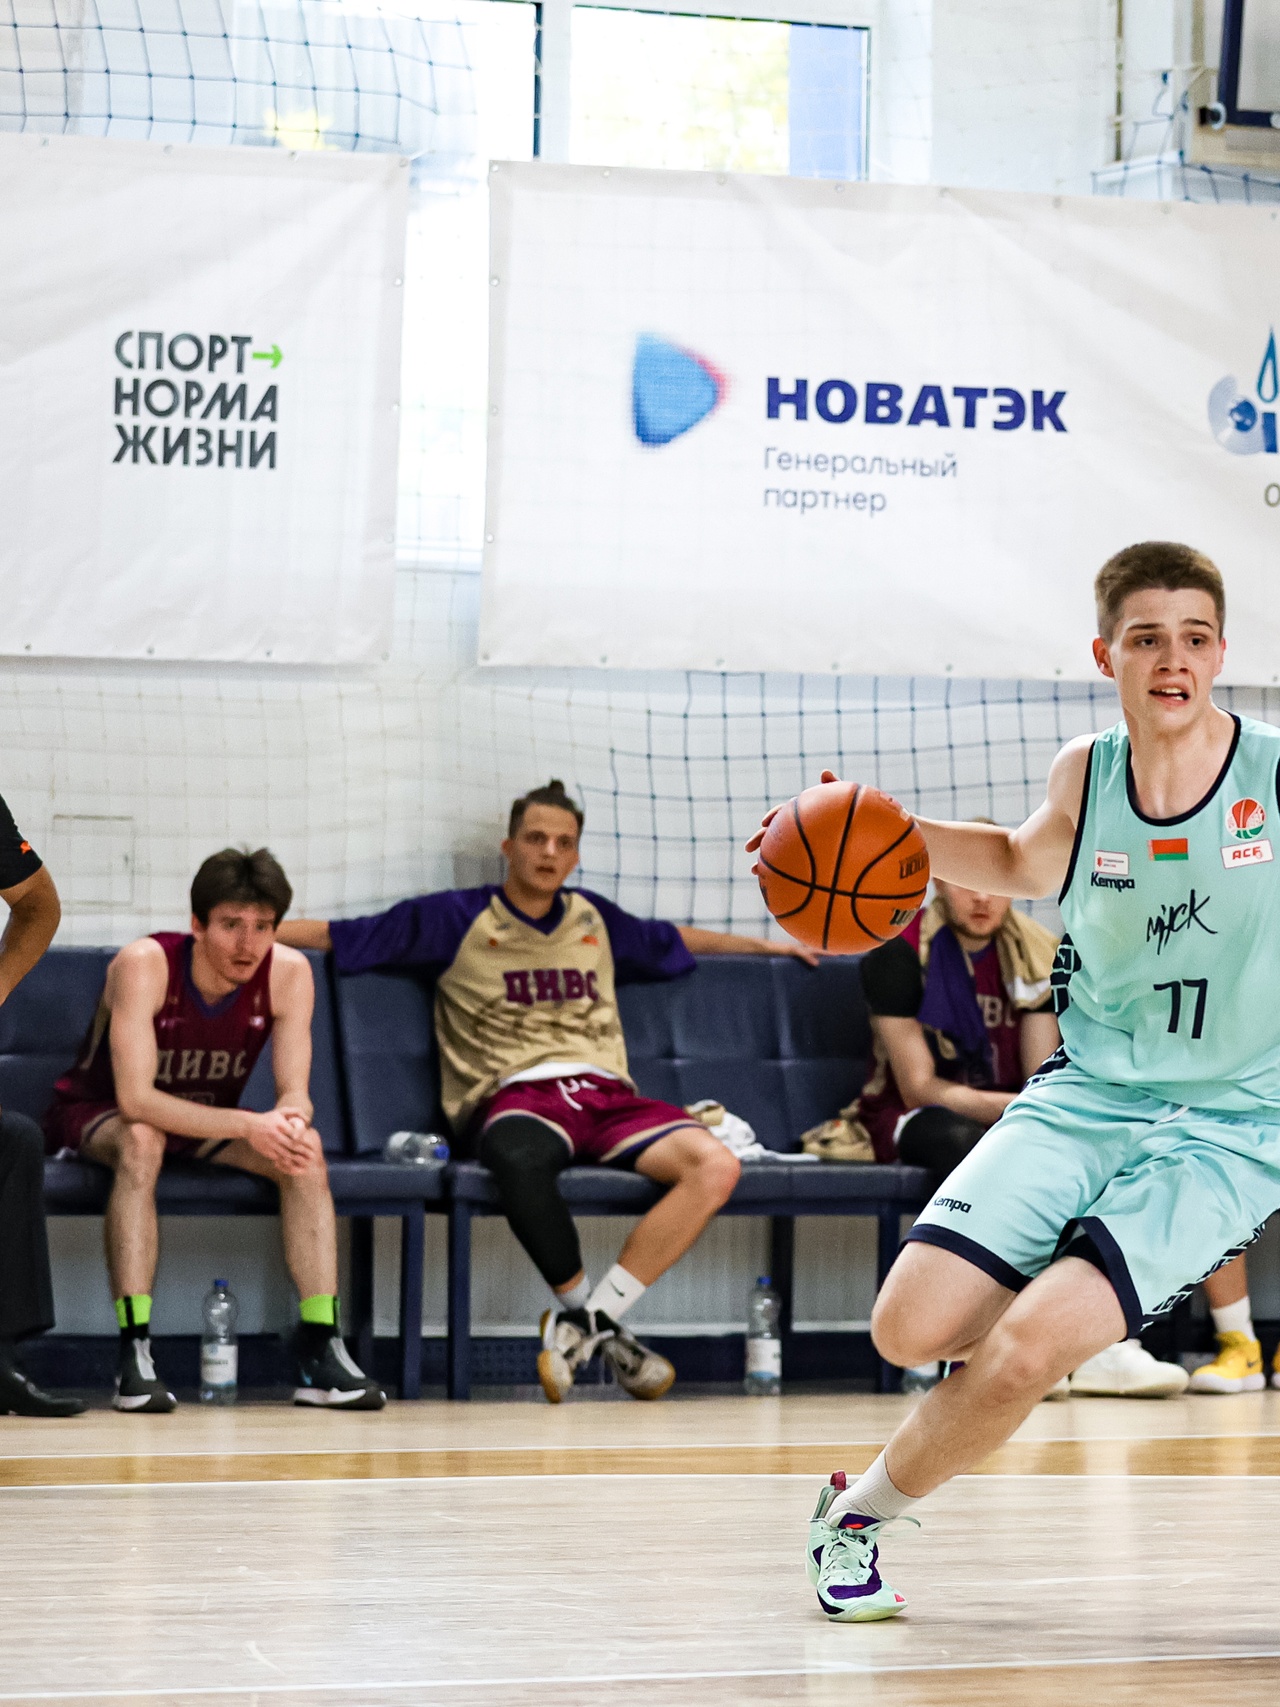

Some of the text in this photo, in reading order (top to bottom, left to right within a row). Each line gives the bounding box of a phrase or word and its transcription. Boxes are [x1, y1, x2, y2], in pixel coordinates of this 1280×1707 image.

[115, 331, 252, 373] СПОРТ
[114, 377, 278, 422] НОРМА
[766, 377, 1068, 433] НОВАТЭК
[112, 424, 277, 469] ЖИЗНИ
[764, 447, 957, 478] Генеральный
[763, 487, 887, 518] партнер
[1090, 871, 1136, 893] Kempa
[1153, 977, 1209, 1040] 77
[934, 1195, 973, 1214] empa
